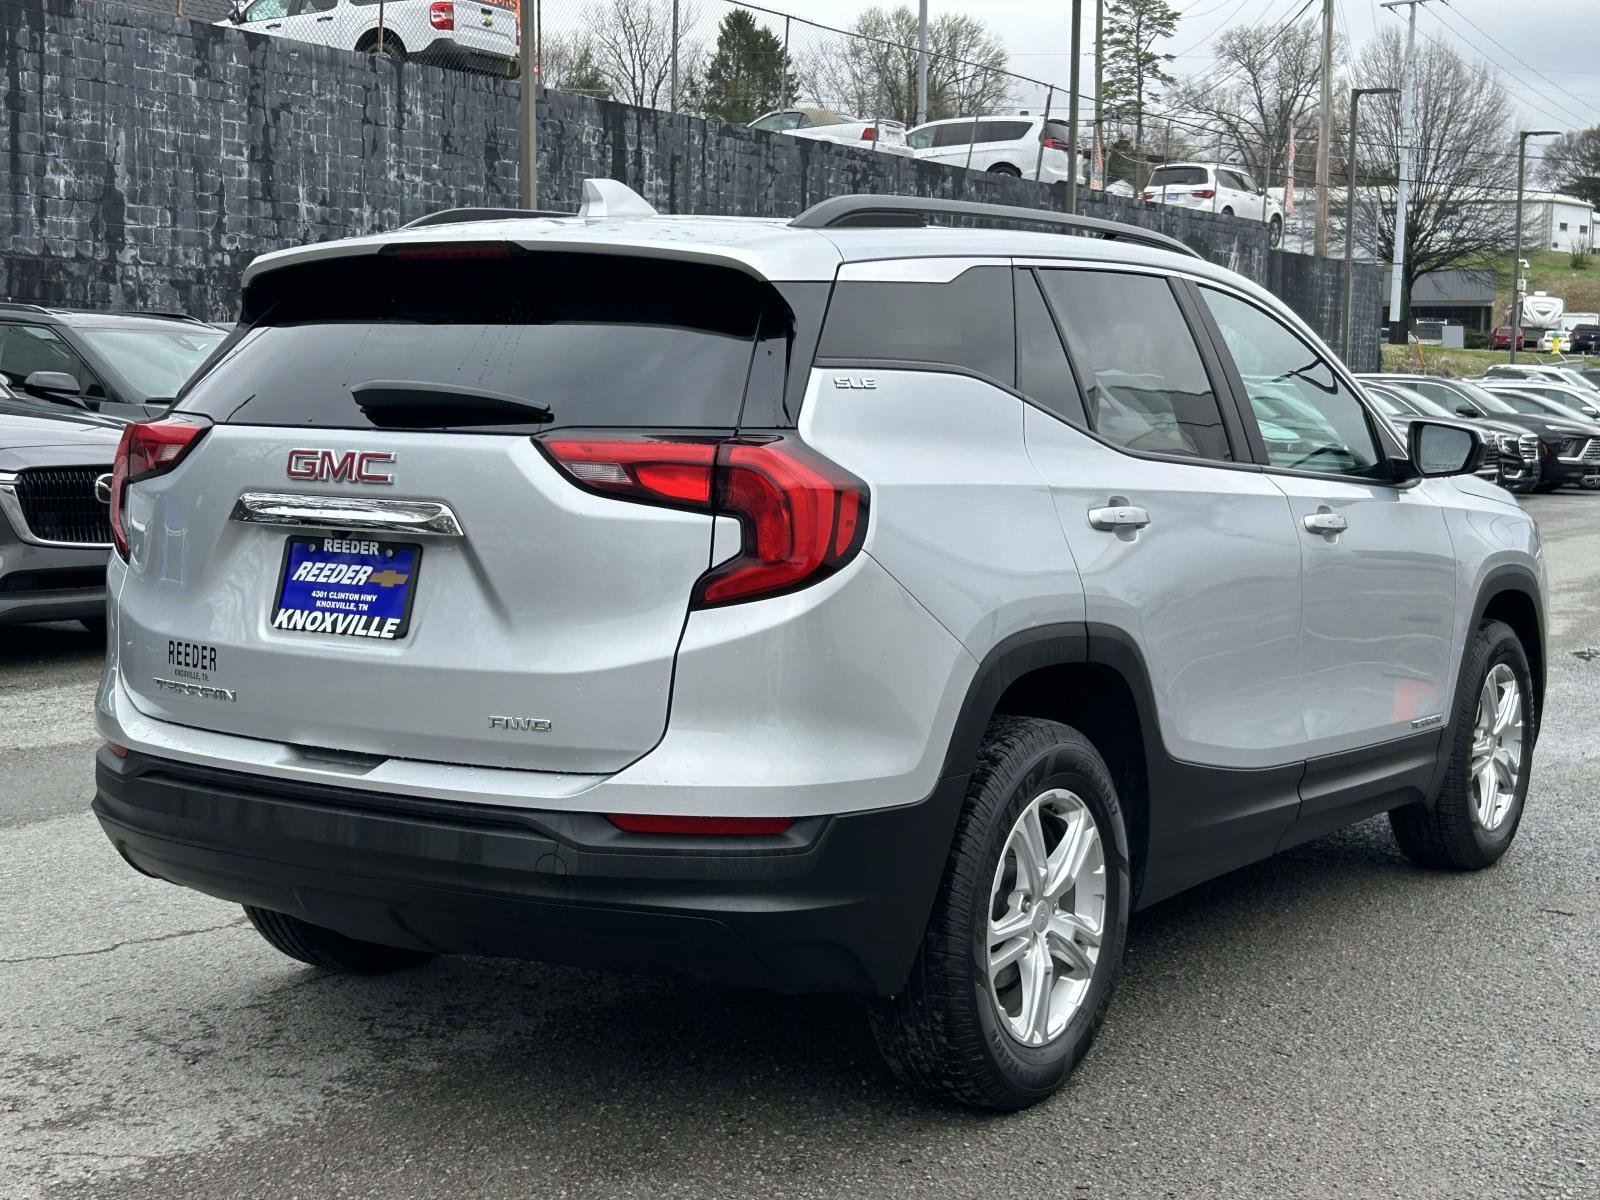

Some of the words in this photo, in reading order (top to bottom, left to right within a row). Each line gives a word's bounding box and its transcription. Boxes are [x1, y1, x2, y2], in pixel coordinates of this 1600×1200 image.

[833, 377, 877, 390] SLE
[286, 448, 397, 484] GMC
[323, 538, 379, 556] REEDER
[292, 561, 374, 586] REEDER
[311, 590, 328, 598] 4301
[329, 591, 360, 601] CLINTON
[360, 594, 378, 602] HWY
[315, 600, 357, 611] KNOXVILLE,
[358, 603, 369, 611] TN
[272, 608, 401, 639] KNOXVILLE
[168, 640, 217, 672] REEDER
[488, 715, 552, 733] AWD
